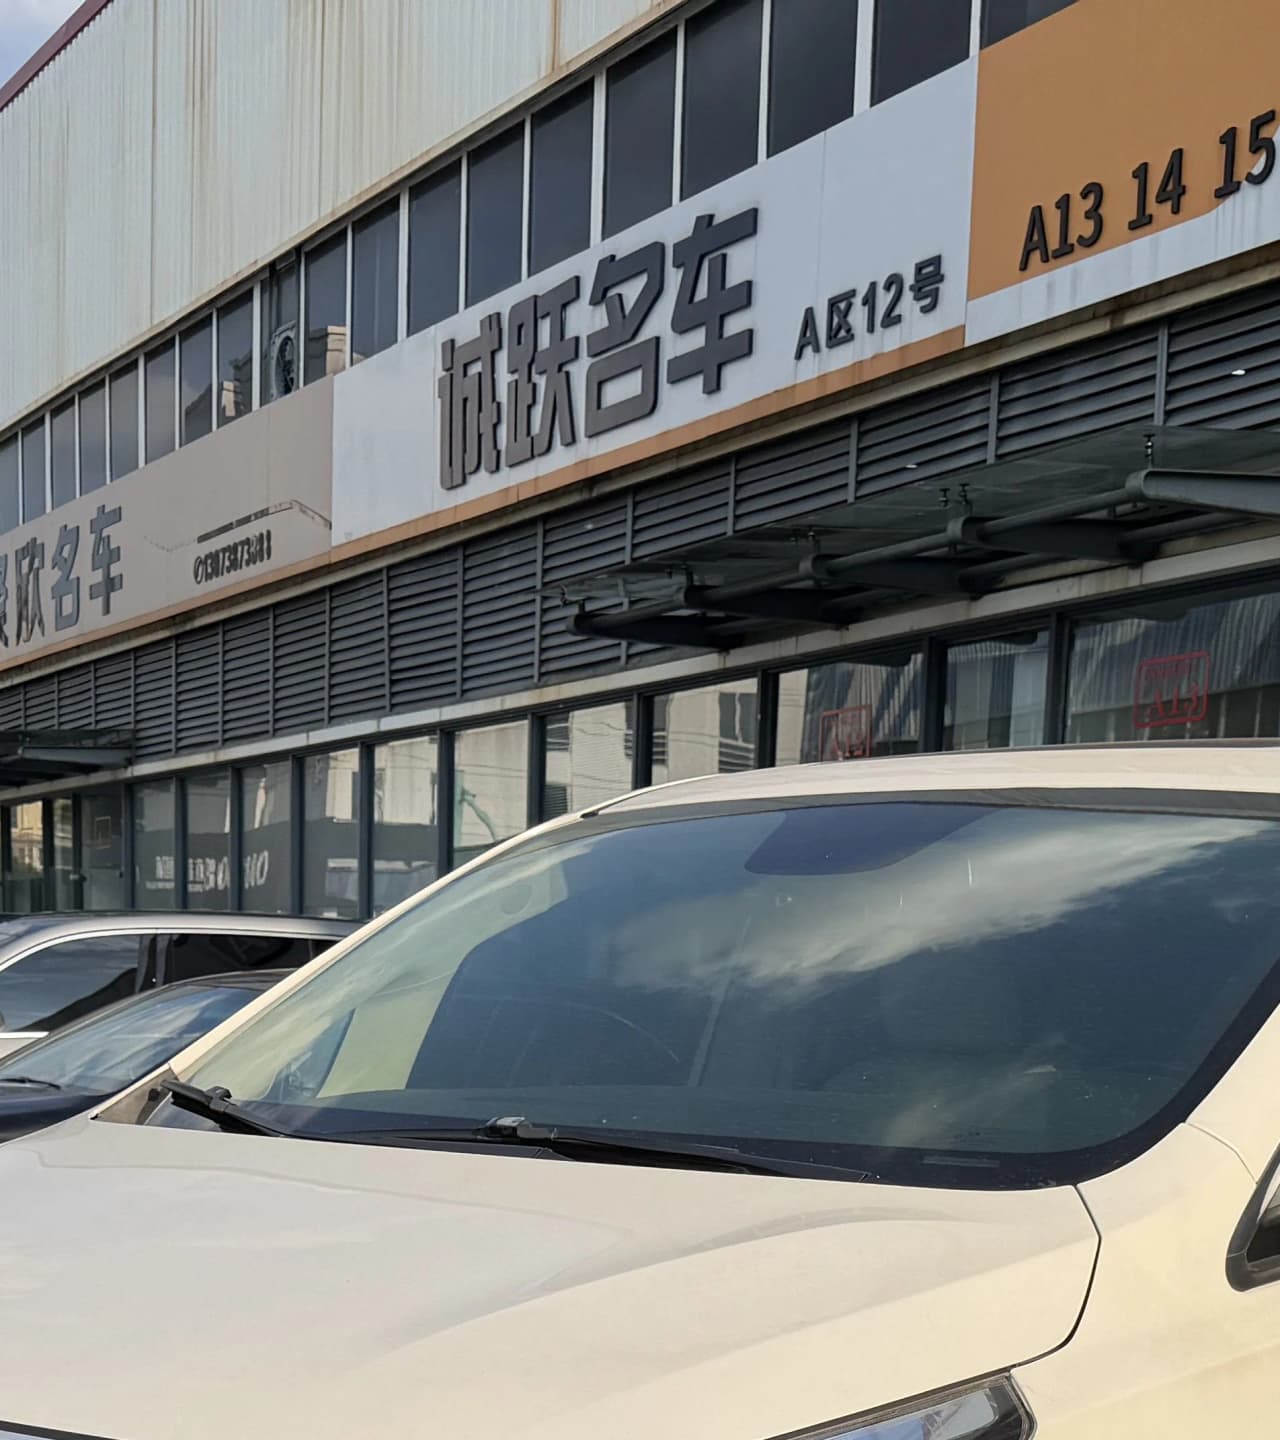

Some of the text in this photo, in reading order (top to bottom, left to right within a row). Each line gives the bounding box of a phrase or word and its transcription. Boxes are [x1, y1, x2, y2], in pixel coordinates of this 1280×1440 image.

[1019, 109, 1277, 272] A13 14 15
[438, 207, 759, 491] 诚跃名车
[794, 253, 945, 361] A区12号
